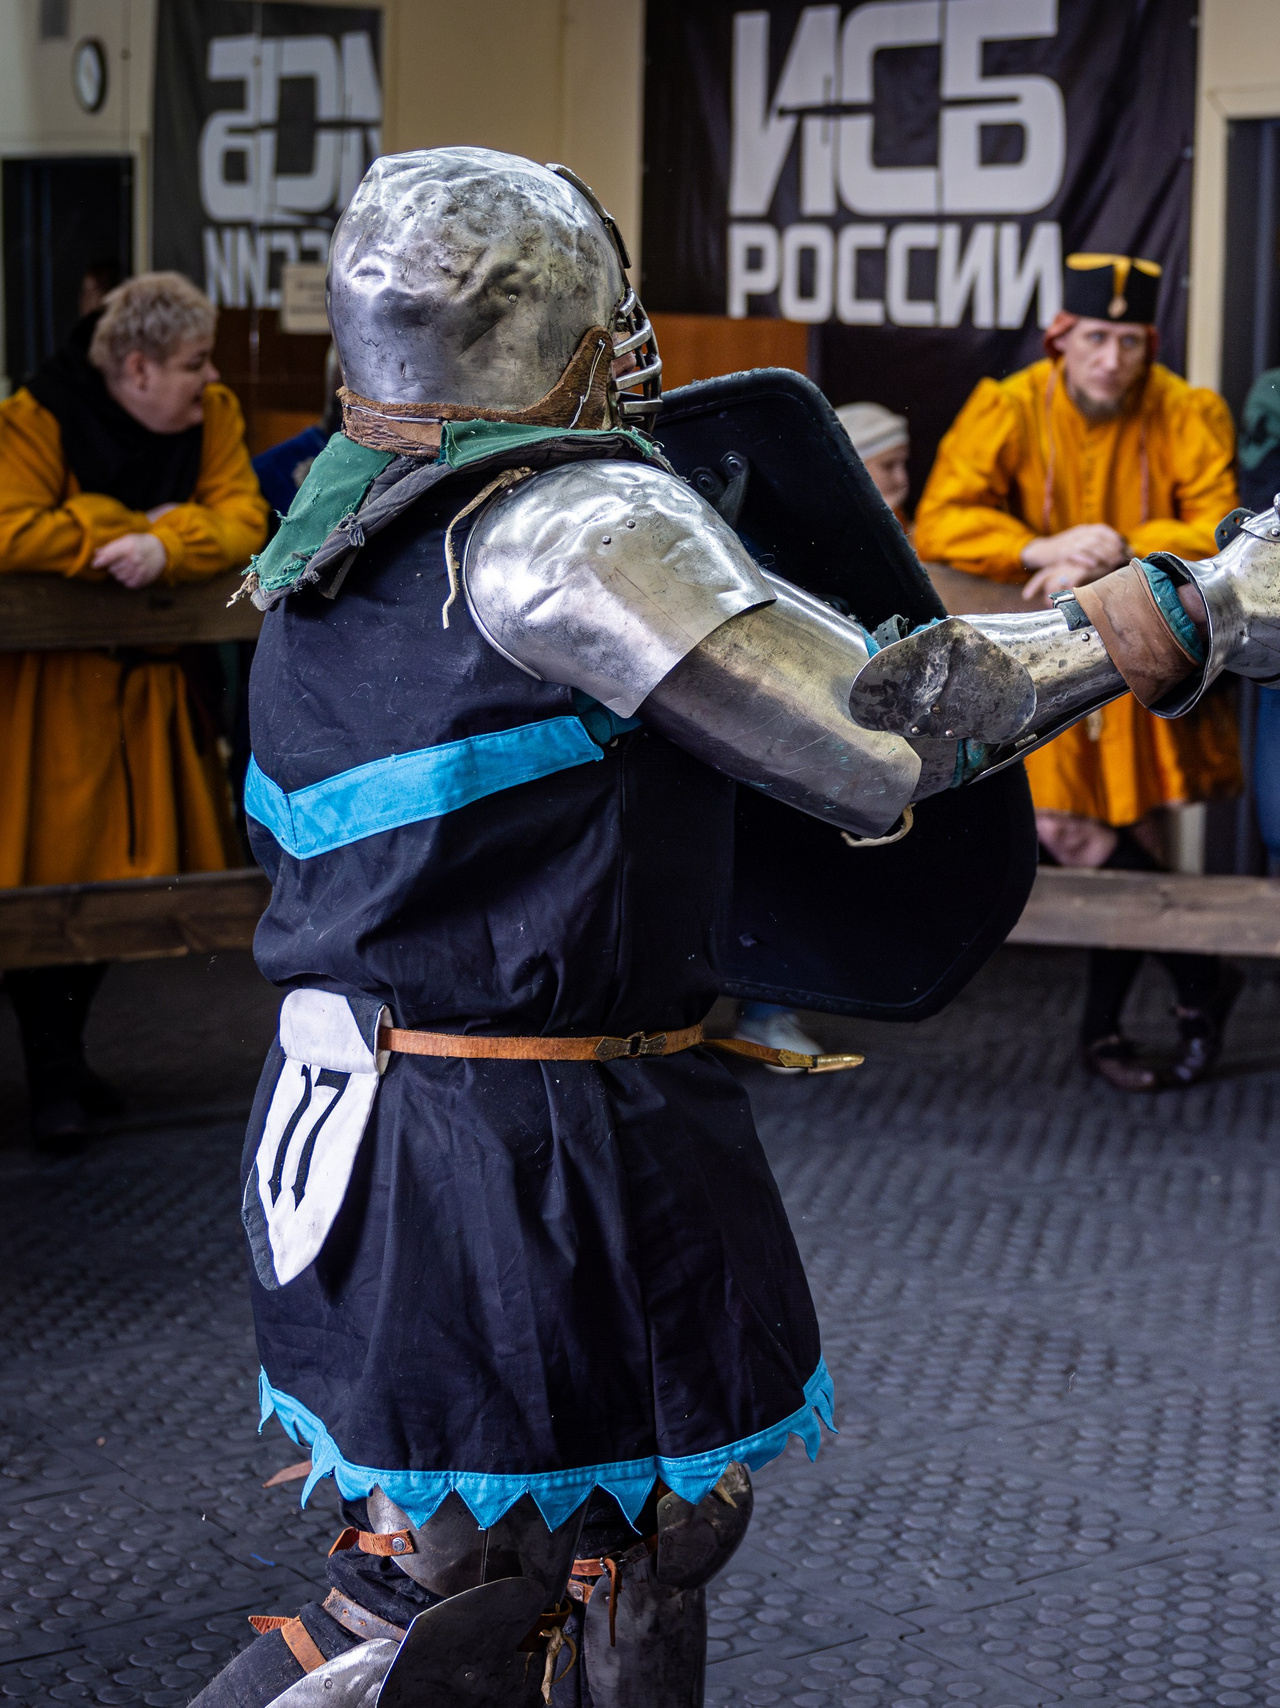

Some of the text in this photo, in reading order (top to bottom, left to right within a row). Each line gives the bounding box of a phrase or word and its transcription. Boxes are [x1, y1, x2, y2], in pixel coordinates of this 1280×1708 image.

[727, 0, 1066, 217] ИСБ
[726, 221, 1065, 330] РОССИИ
[267, 1064, 352, 1212] 17
